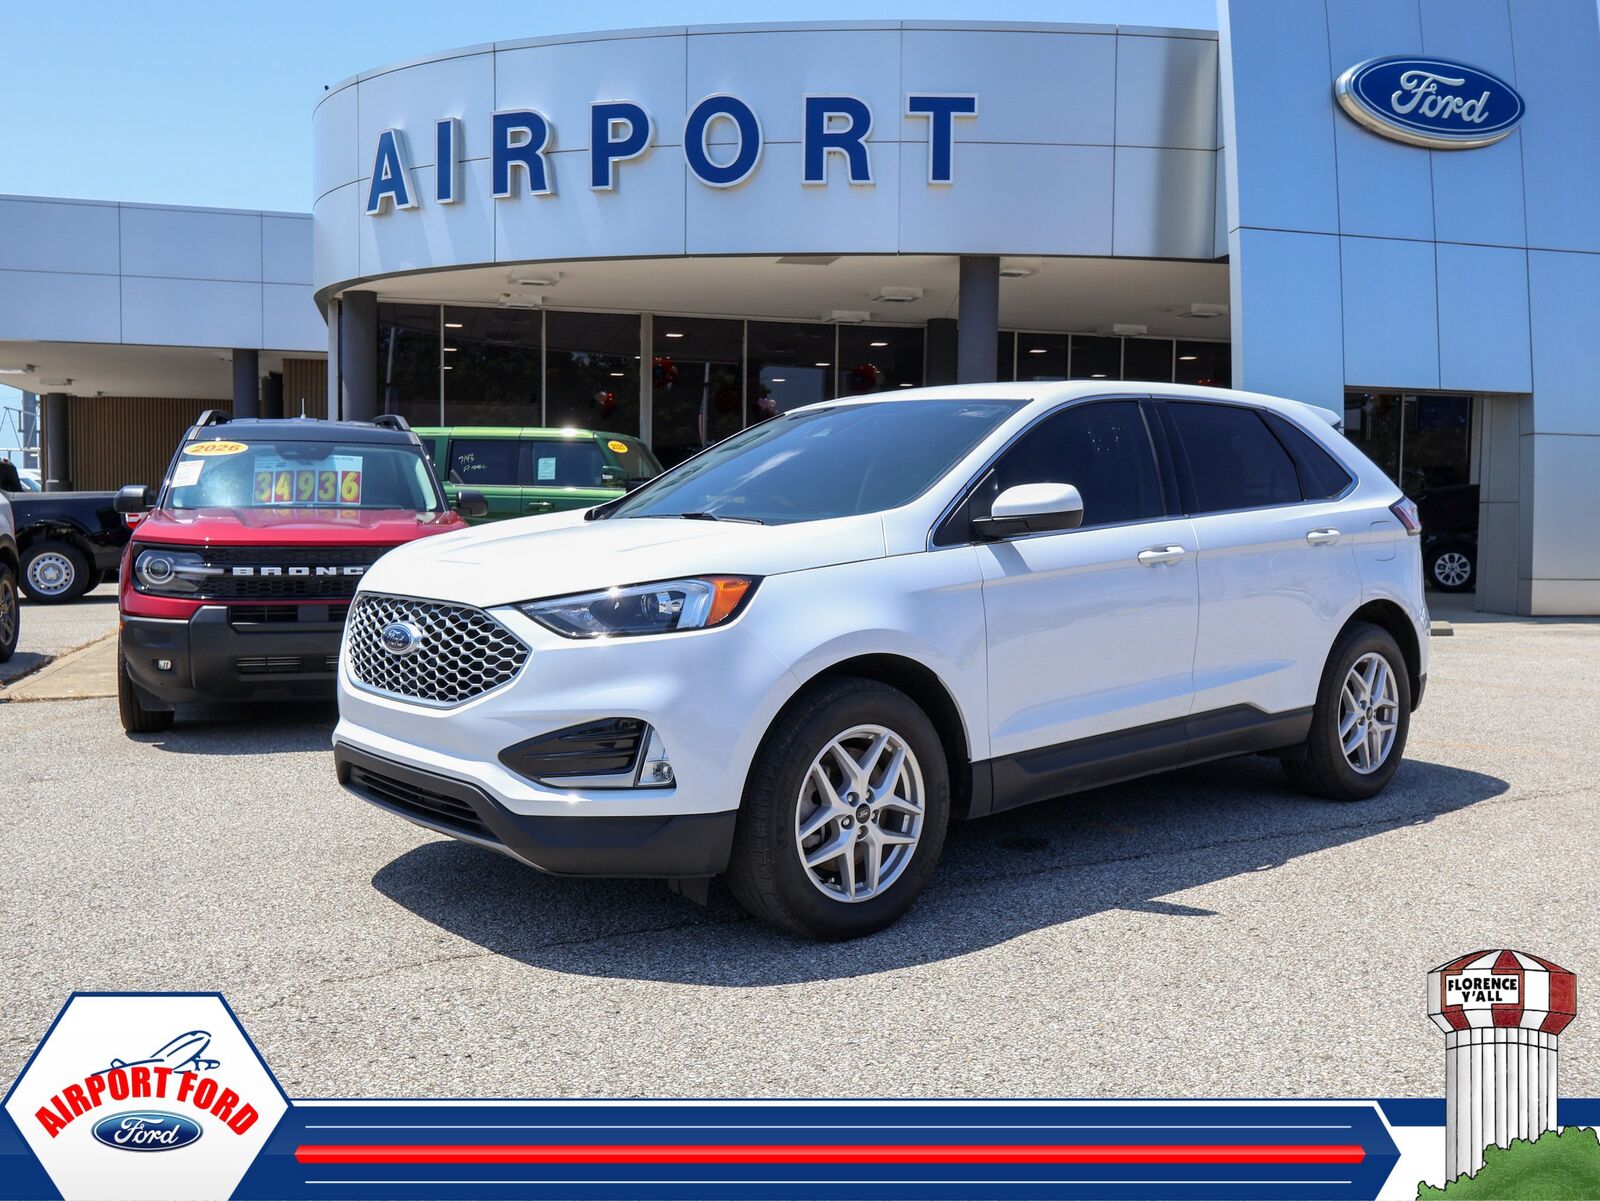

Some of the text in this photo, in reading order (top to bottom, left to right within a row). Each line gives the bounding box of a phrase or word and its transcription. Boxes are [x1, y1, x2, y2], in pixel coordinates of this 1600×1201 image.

[1391, 70, 1490, 123] Ford
[365, 93, 979, 216] AIRPORT
[195, 442, 240, 453] 2026
[255, 471, 358, 502] 34936
[232, 567, 364, 576] BRONC
